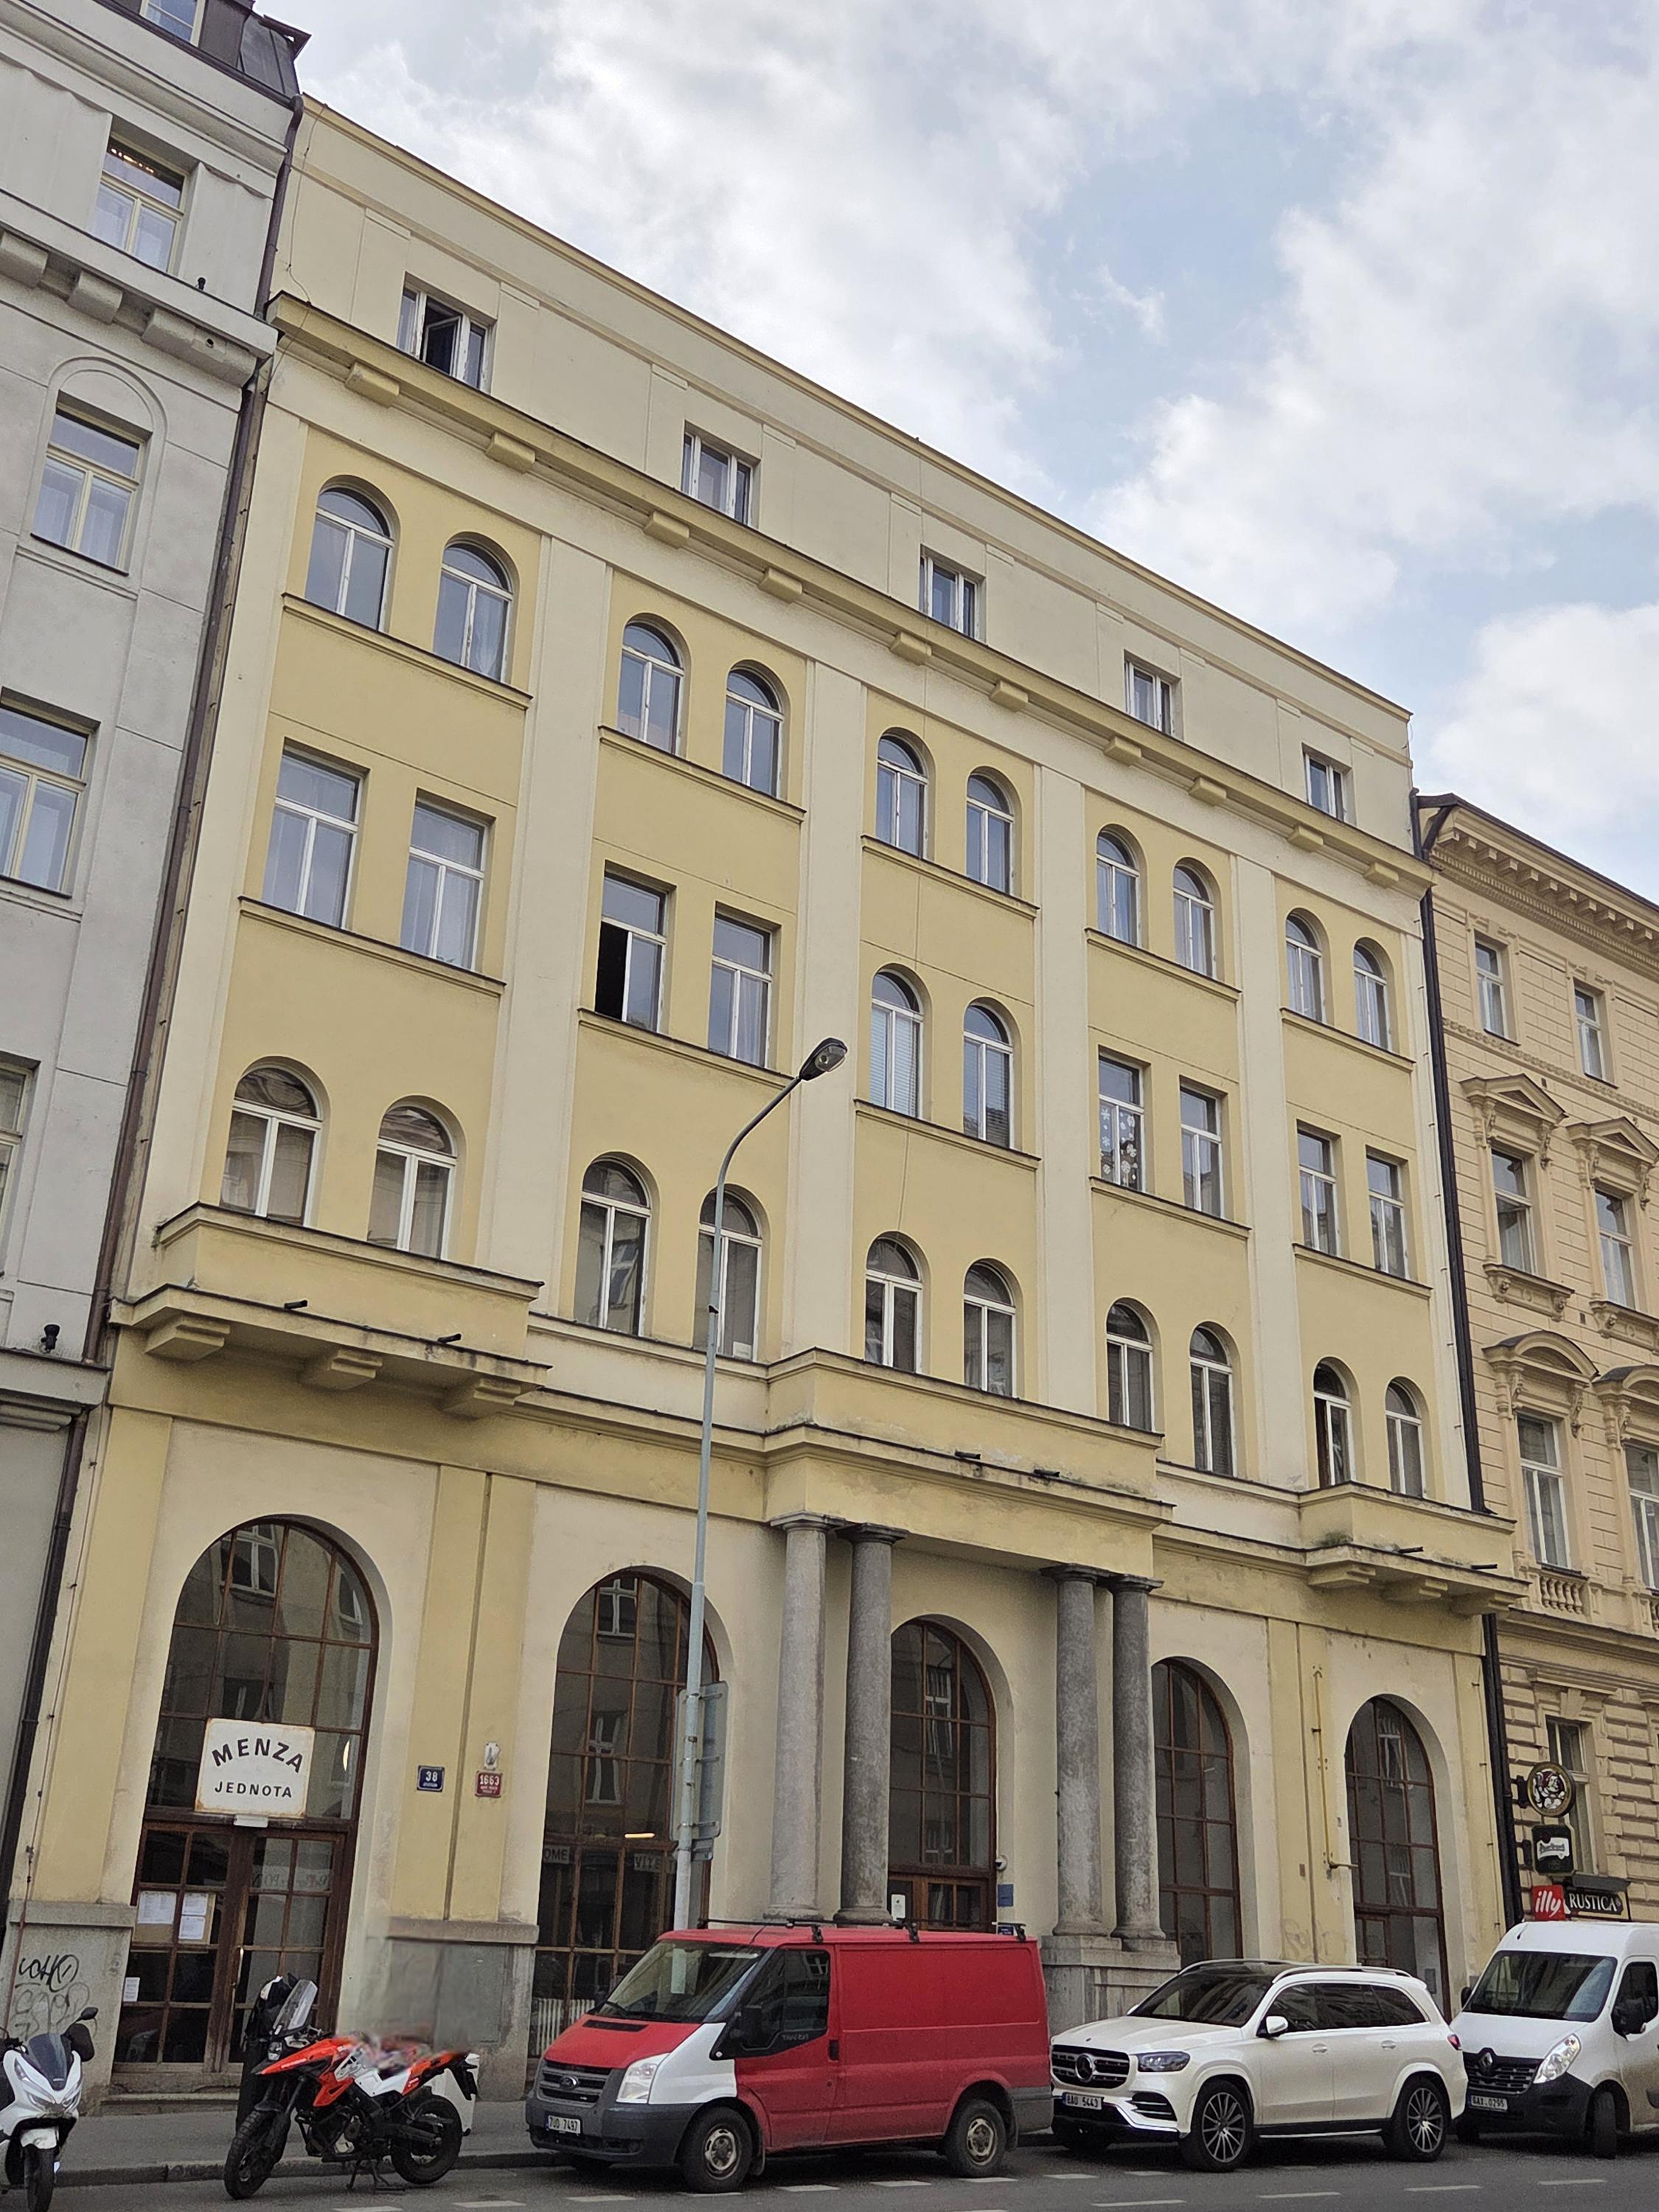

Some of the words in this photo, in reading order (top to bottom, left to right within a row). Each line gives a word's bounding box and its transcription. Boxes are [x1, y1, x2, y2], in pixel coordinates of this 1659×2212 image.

[212, 1738, 303, 1773] MENZA
[425, 1771, 438, 1782] 38
[479, 1775, 500, 1786] 1663
[215, 1781, 292, 1798] JEDNOTA
[1535, 1890, 1561, 1918] illy
[1569, 1893, 1617, 1912] RUSTICA
